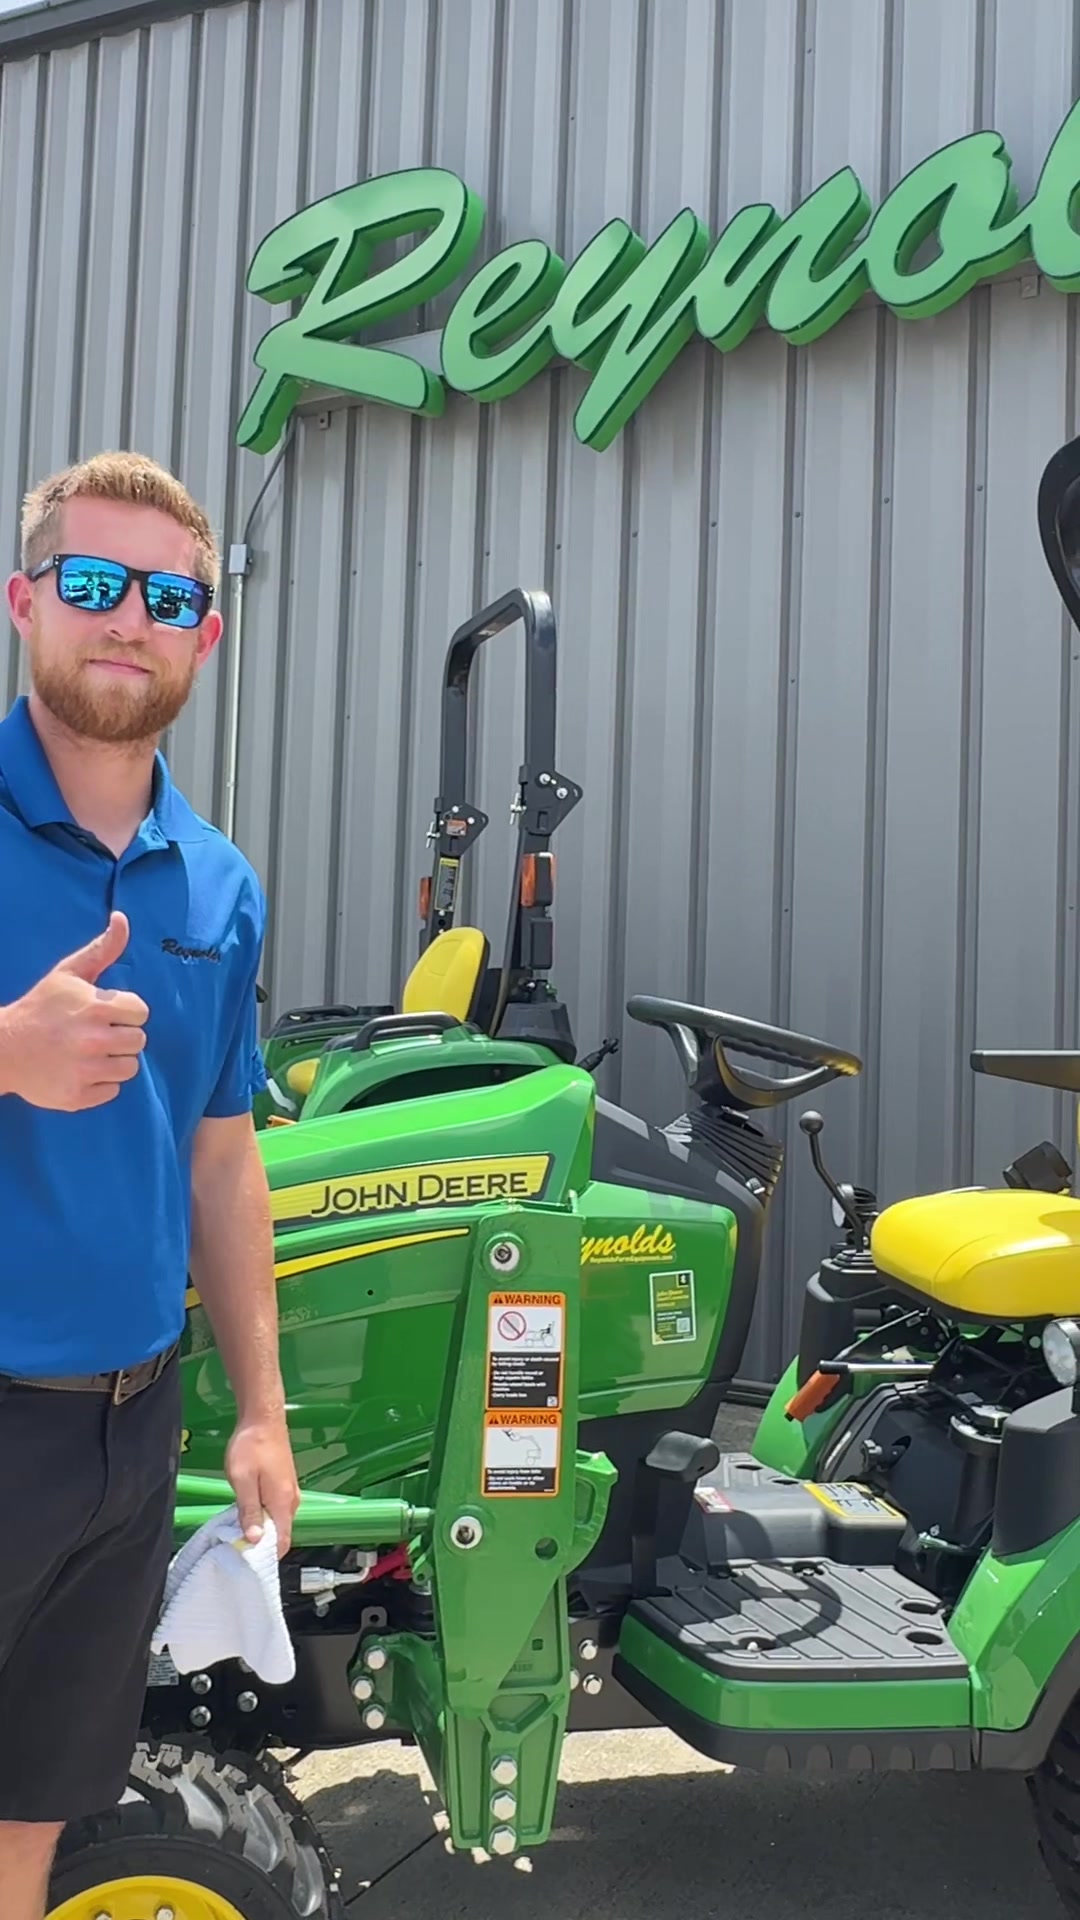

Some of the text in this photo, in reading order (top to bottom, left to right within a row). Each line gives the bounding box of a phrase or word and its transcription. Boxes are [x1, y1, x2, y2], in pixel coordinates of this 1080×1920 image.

[311, 1172, 528, 1215] JOHN DEERE
[504, 1294, 561, 1305] WARNING
[500, 1414, 557, 1425] WARNING
